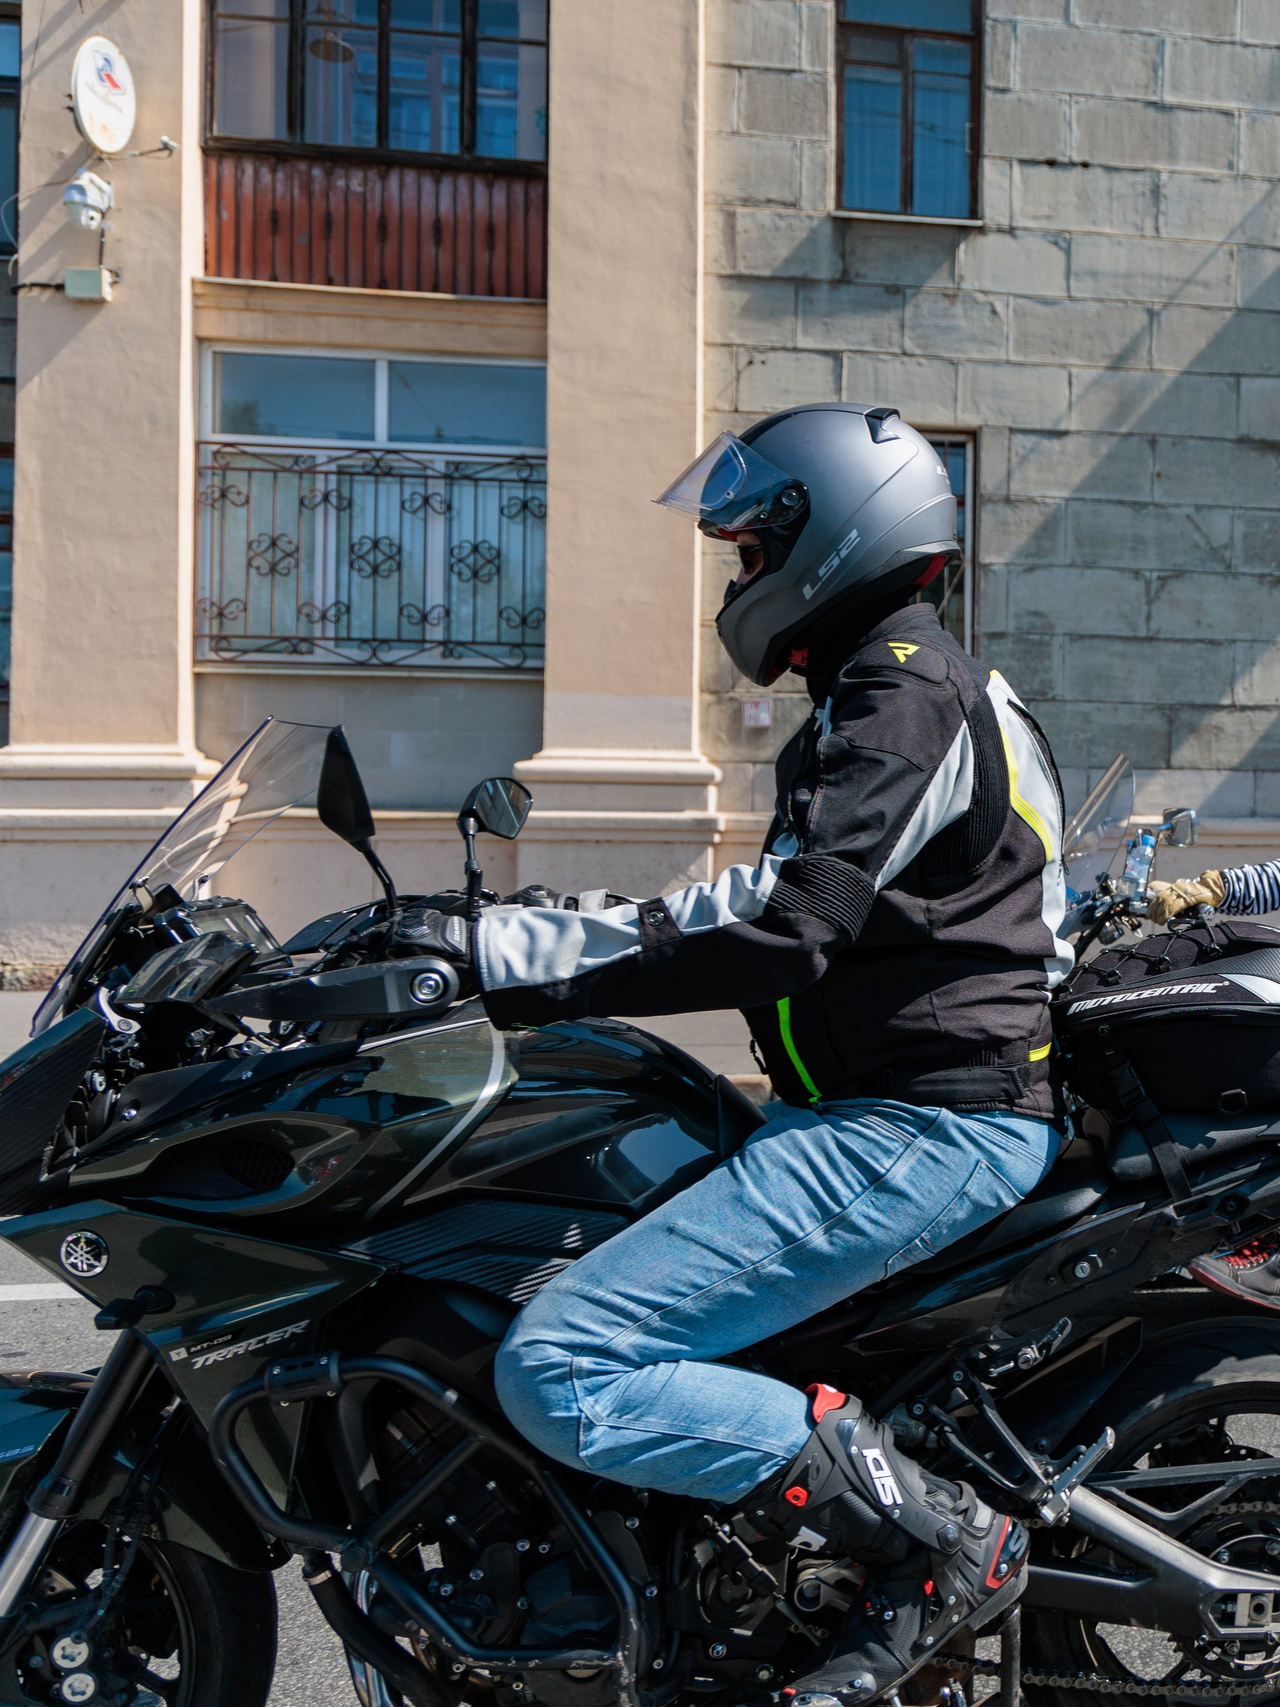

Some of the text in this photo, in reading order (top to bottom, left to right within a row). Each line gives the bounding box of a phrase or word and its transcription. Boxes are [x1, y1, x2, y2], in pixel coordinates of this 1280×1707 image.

[802, 528, 861, 600] LS2
[1066, 982, 1224, 1016] MOTOCENTRIC
[190, 1334, 233, 1353] MT-09
[191, 1319, 311, 1370] TRACER
